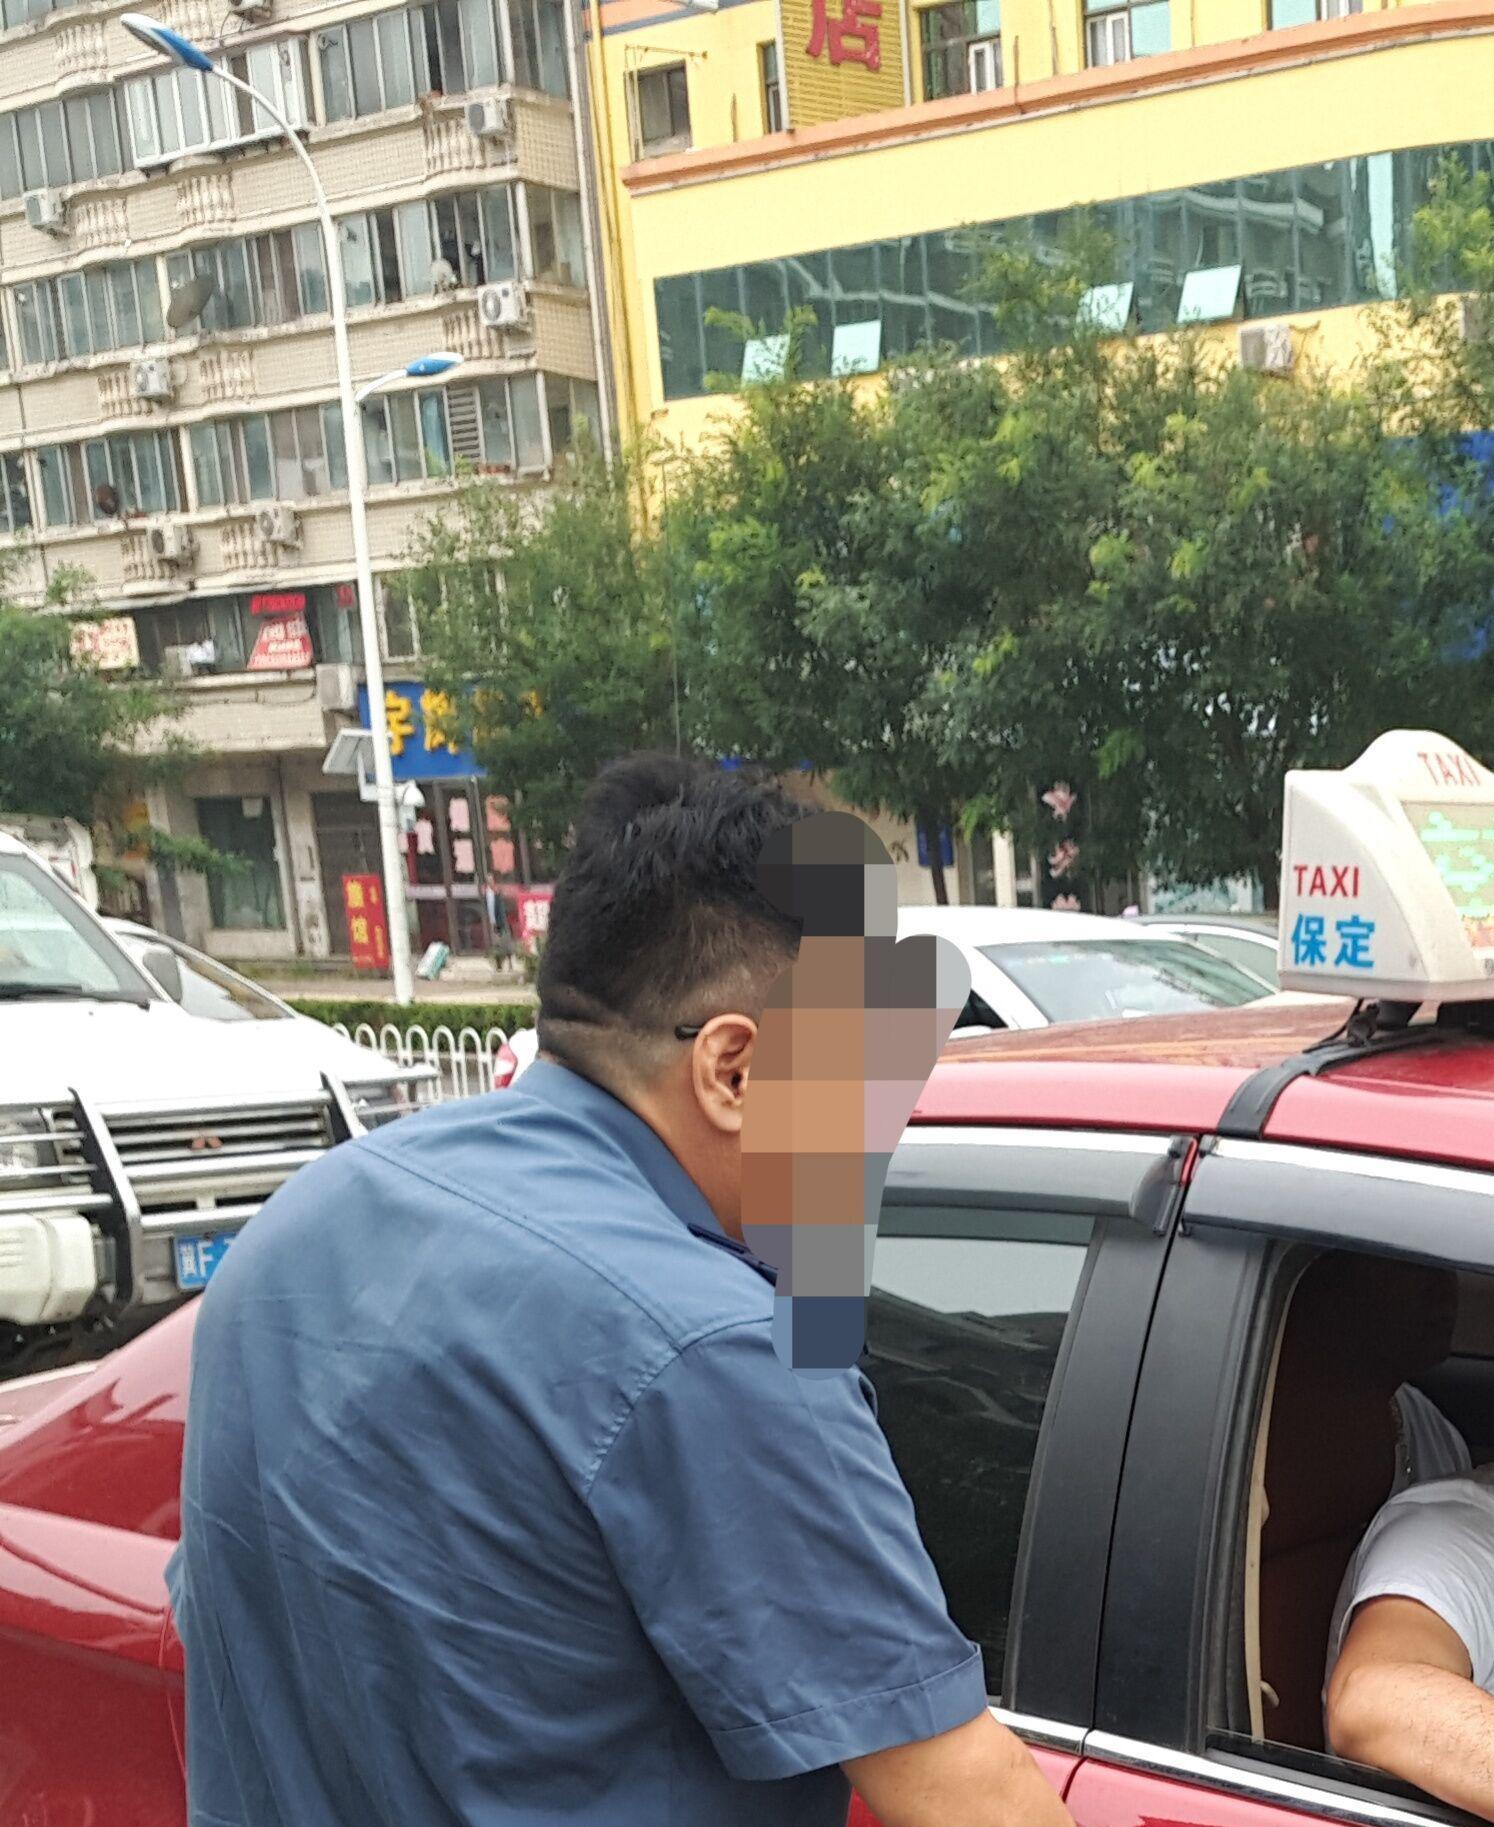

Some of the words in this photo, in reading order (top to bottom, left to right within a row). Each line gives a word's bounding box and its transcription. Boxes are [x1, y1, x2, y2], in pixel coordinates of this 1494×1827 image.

[1417, 752, 1482, 786] TAXI
[1293, 865, 1360, 898] TAXI
[1291, 912, 1376, 969] 保定
